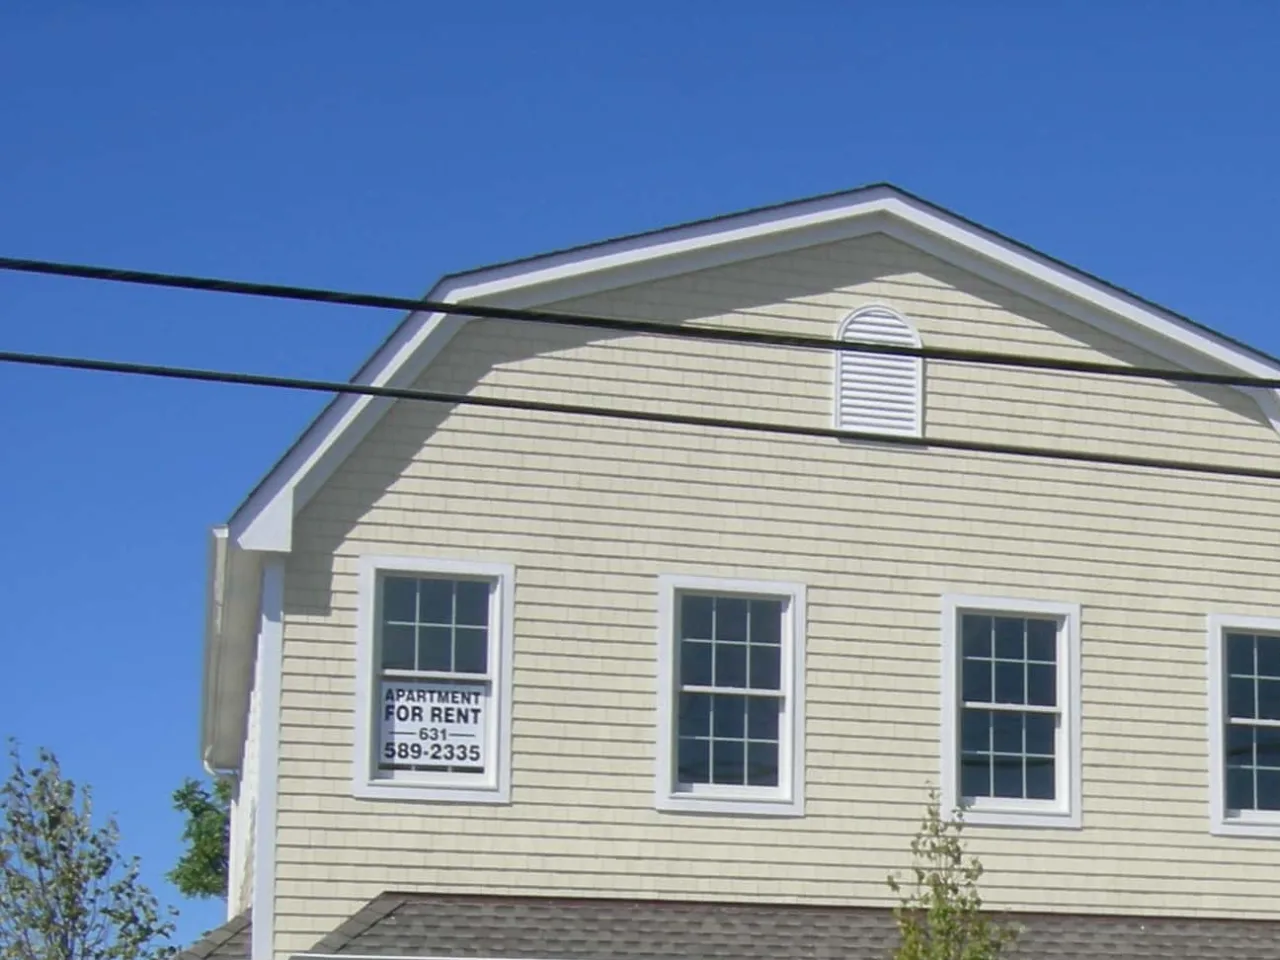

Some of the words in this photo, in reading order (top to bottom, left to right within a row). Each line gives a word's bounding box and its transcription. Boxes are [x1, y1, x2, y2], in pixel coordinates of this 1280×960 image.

[385, 688, 482, 706] APARTMENT
[384, 705, 423, 722] FOR
[430, 707, 482, 724] RENT
[418, 728, 448, 741] 631
[383, 742, 481, 761] 589-2335
